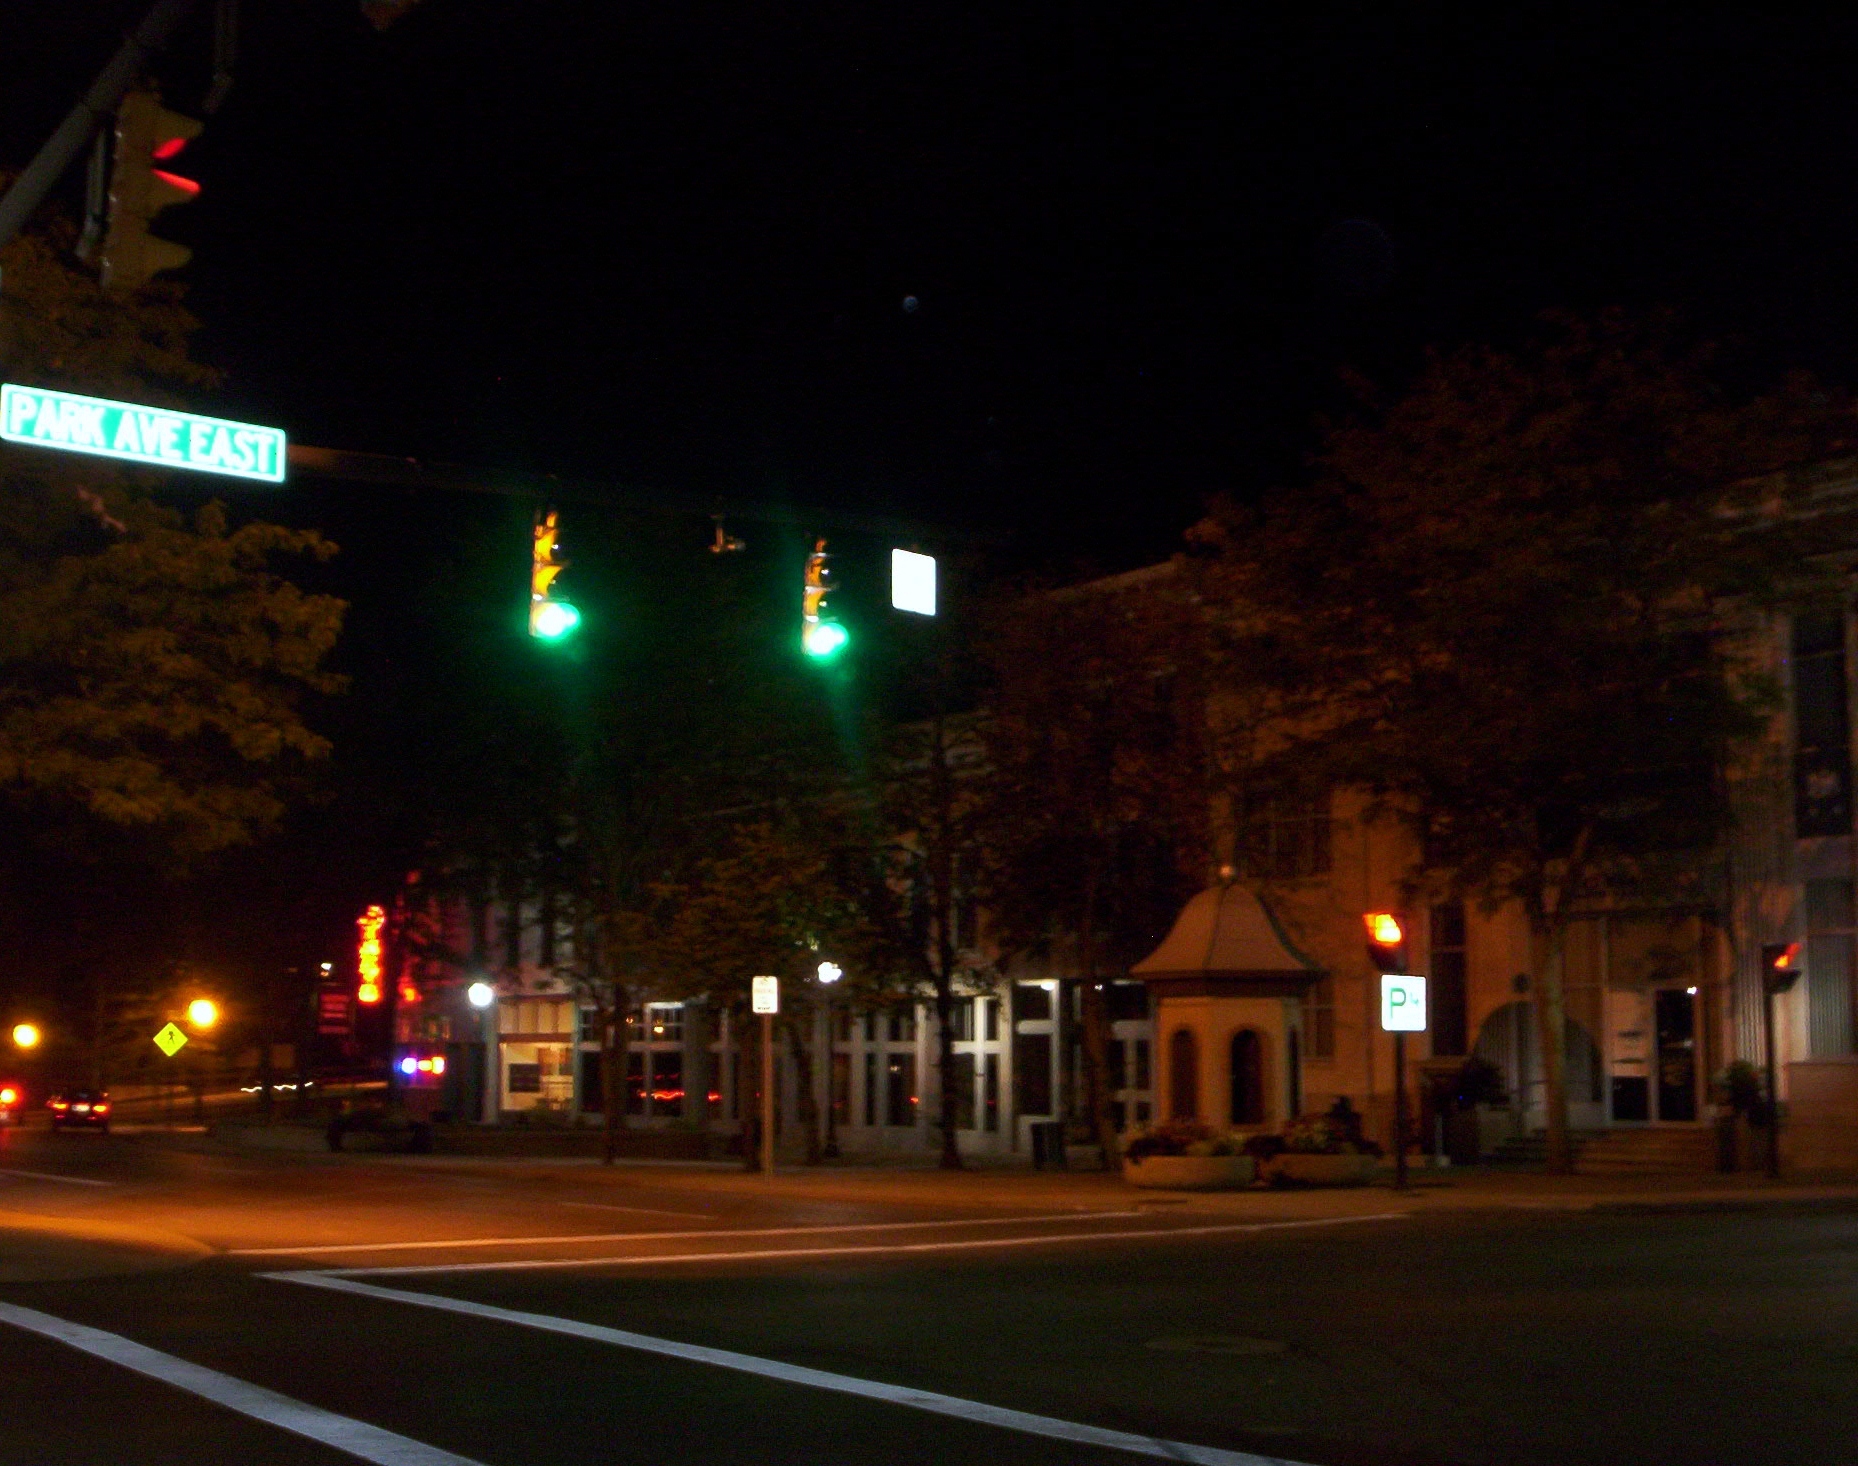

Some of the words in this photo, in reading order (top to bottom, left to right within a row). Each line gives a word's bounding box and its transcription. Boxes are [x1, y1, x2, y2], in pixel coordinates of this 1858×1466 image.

[10, 393, 105, 447] PARK
[113, 411, 183, 461] AVE
[189, 421, 274, 473] EAST
